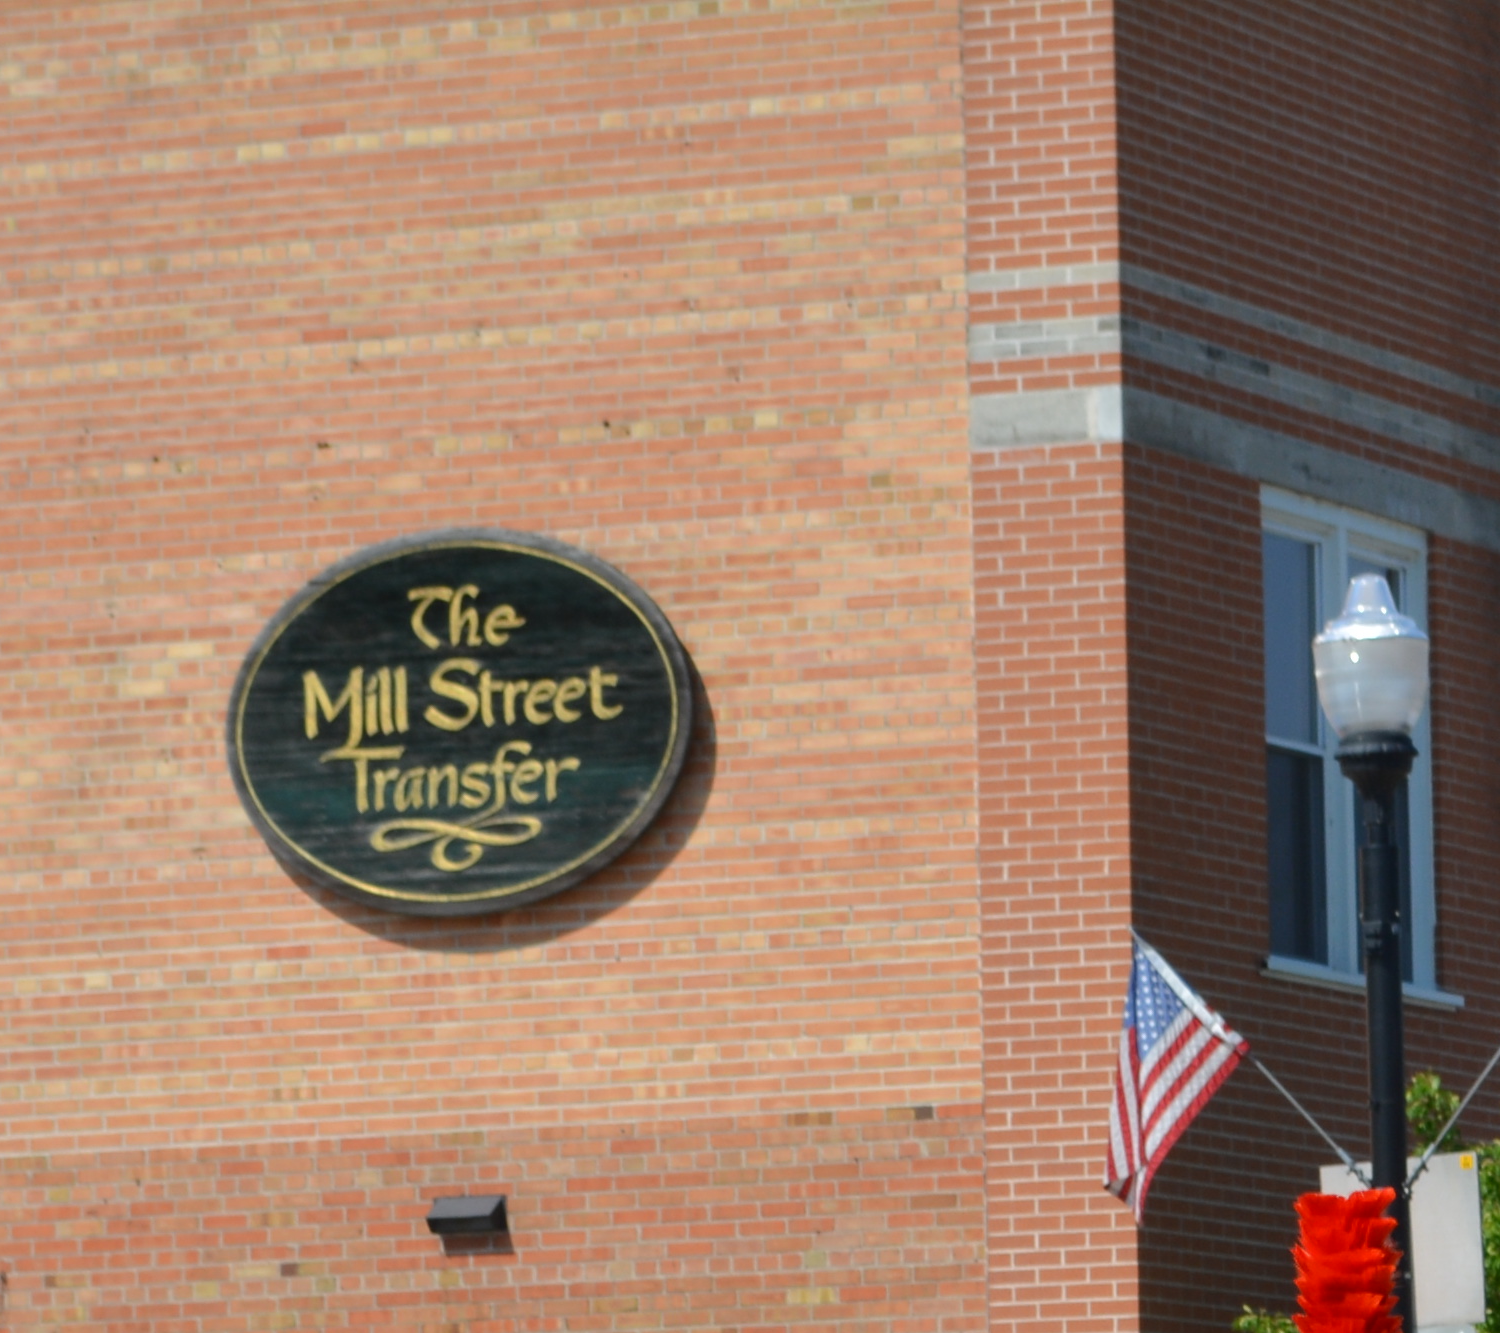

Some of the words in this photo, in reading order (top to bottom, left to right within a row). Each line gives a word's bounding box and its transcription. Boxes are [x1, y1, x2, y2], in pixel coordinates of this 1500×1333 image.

[408, 584, 527, 650] The
[303, 664, 410, 756] Mill
[424, 657, 624, 732] Street
[319, 740, 581, 815] Transfer
